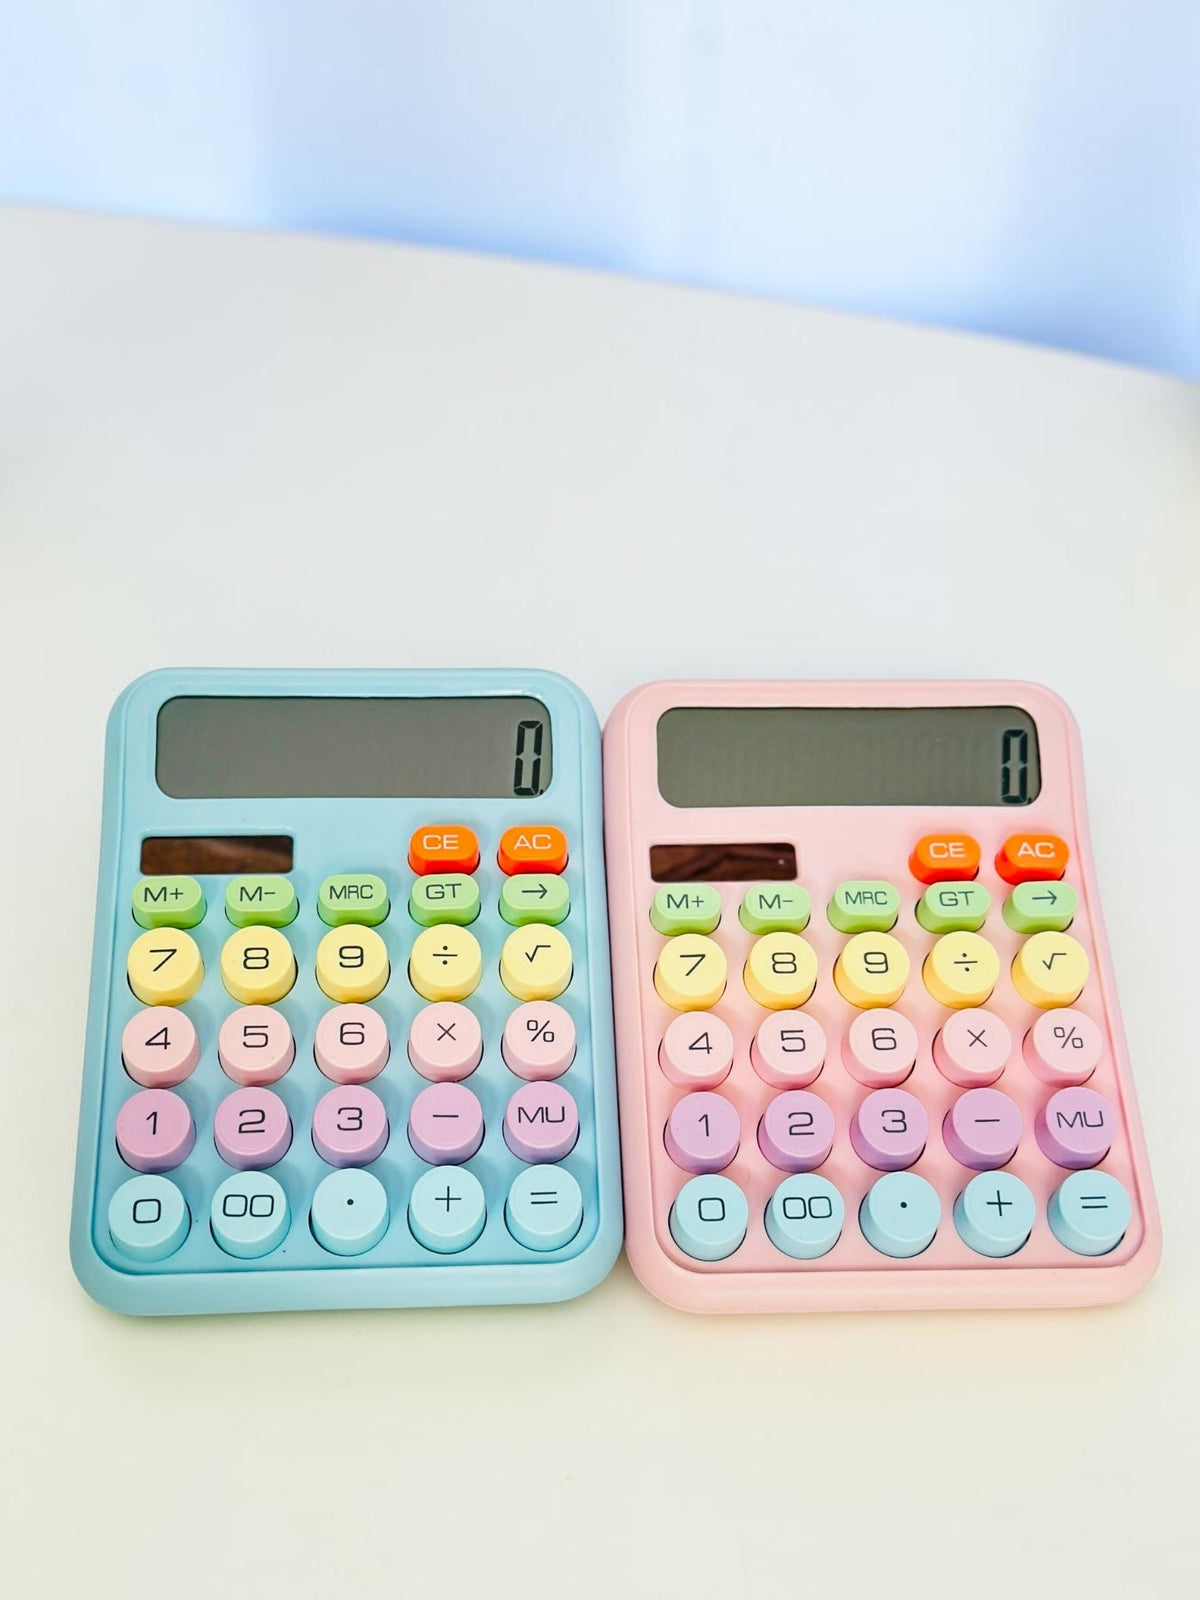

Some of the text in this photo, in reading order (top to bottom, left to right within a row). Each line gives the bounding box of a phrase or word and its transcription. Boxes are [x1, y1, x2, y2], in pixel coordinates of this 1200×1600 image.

[422, 834, 460, 850] CE
[513, 834, 552, 850] AC
[929, 841, 965, 858] CE
[1017, 841, 1055, 858] AC
[145, 887, 183, 902] M+
[240, 887, 275, 901] M-
[330, 885, 373, 899] MRC
[426, 883, 462, 899] GT
[667, 894, 704, 908] M+
[759, 895, 792, 909] M-
[845, 892, 887, 905] MRC
[939, 891, 974, 906] GT
[150, 949, 177, 971] 7
[243, 948, 269, 969] 8
[339, 946, 363, 968] 9
[680, 954, 705, 976] 7
[772, 953, 796, 973] 8
[864, 952, 888, 973] 9
[145, 1027, 170, 1049] 4
[243, 1026, 268, 1048] 5
[340, 1023, 364, 1045] 6
[689, 1032, 712, 1054] 4
[781, 1030, 805, 1052] 5
[872, 1028, 896, 1050] 6
[147, 1112, 157, 1135] 1
[239, 1109, 265, 1133] 2
[337, 1107, 362, 1131] 3
[518, 1107, 565, 1123] MU
[699, 1114, 709, 1136] 1
[788, 1112, 814, 1135] 2
[882, 1110, 907, 1133] 3
[1057, 1111, 1103, 1128] MU
[133, 1199, 161, 1223] 0
[223, 1195, 274, 1217] 00
[698, 1198, 725, 1221] 0
[783, 1196, 832, 1219] 00
